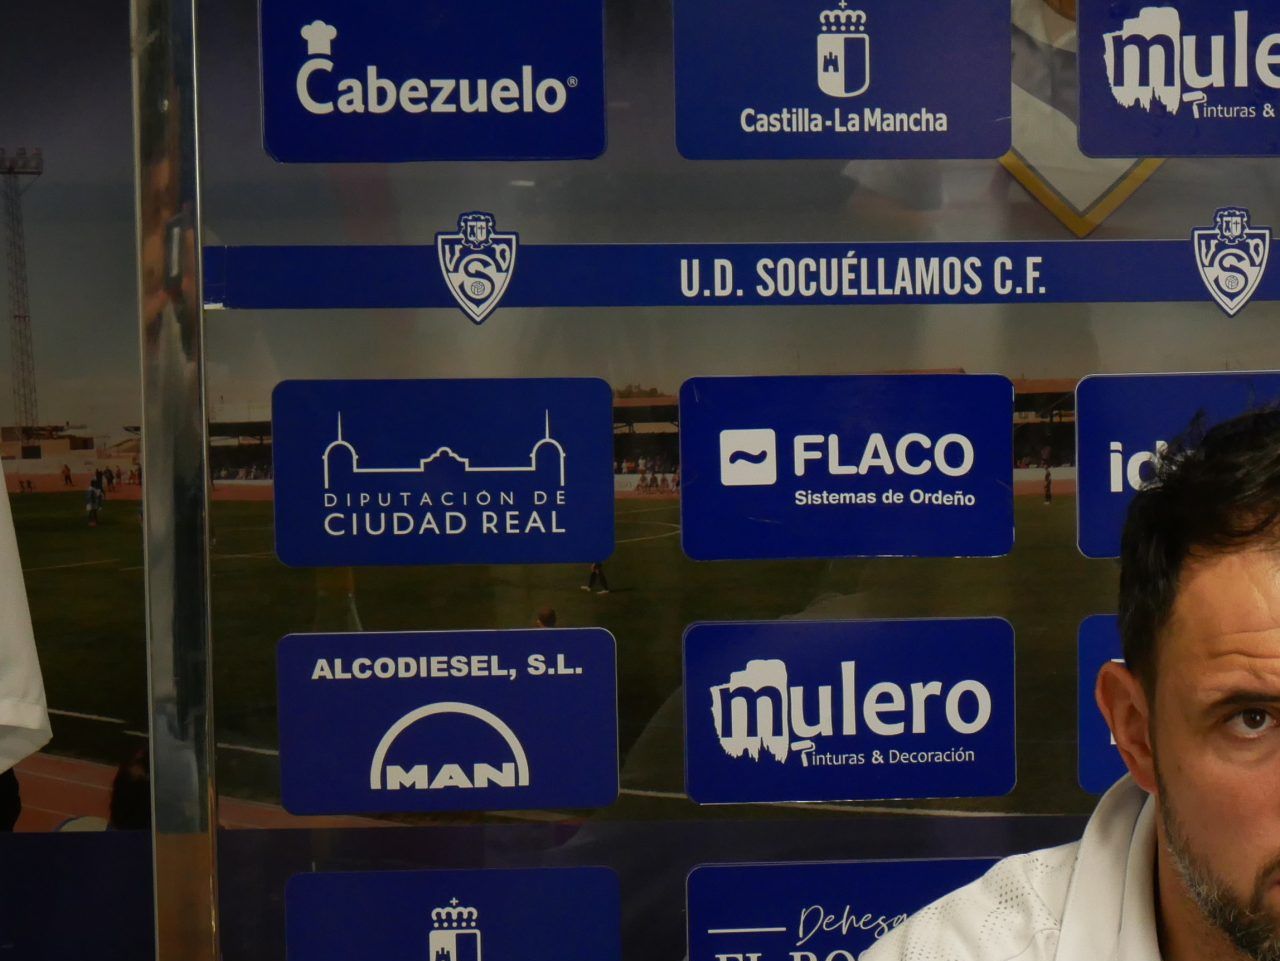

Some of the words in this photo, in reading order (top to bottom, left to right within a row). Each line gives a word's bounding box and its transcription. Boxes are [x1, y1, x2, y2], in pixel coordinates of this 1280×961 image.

[864, 108, 947, 132] Mancha
[1262, 103, 1276, 118] &
[679, 258, 744, 298] U.D.
[755, 250, 983, 297] SOCUÉLLAMOS
[993, 256, 1047, 295] C.F.
[793, 432, 975, 477] FLACO
[324, 490, 514, 507] DIPUTACIÓN
[534, 491, 566, 505] DE
[794, 490, 877, 506] Sistemas
[882, 489, 904, 505] de
[909, 489, 976, 506] Ordeño
[323, 511, 467, 536] CIUDAD
[482, 510, 566, 534] REAL
[311, 655, 517, 681] ALCODIESEL,
[527, 654, 583, 675] S.L.
[713, 660, 992, 750] mulero
[872, 750, 885, 765] &
[889, 747, 975, 765] Decoración
[386, 763, 515, 790] MAN
